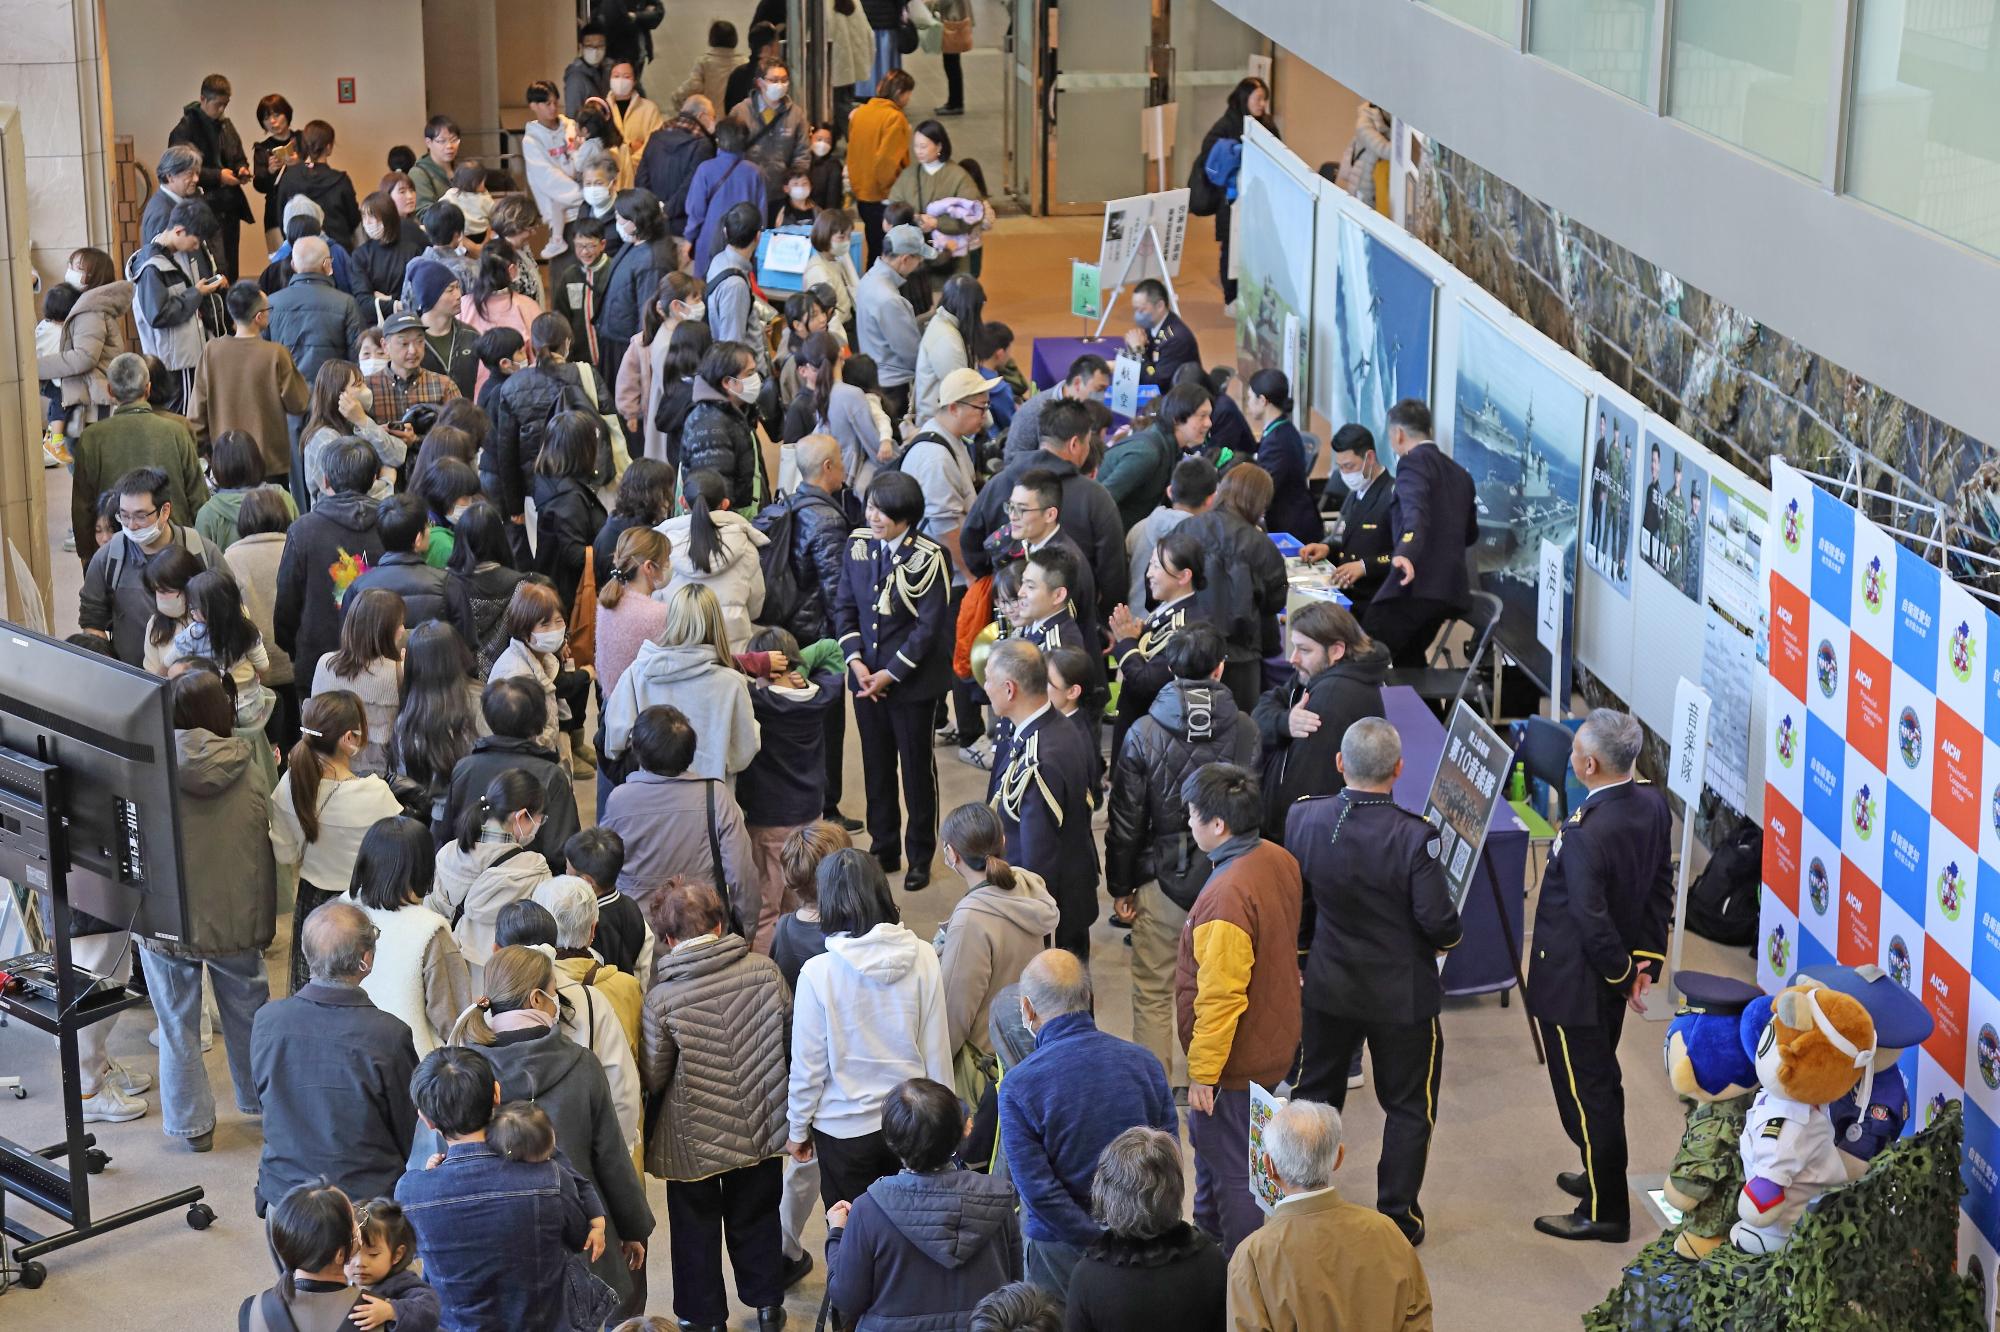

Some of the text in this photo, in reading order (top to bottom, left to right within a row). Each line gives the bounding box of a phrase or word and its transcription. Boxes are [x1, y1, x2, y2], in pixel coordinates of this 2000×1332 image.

[1777, 605, 1793, 625] AICHI
[1855, 668, 1873, 690] AICHI
[1863, 712, 1875, 729] Office
[1681, 701, 1699, 783] 音楽隊
[1941, 739, 1961, 763] AICHI
[1448, 736, 1496, 799] 第10音楽隊
[1947, 761, 1967, 782] Provincial
[1949, 773, 1974, 800] Cooperation
[1952, 786, 1965, 803] Office
[1771, 816, 1786, 838] AICHI
[1845, 890, 1863, 915] AICHI
[1930, 973, 1949, 998] AICHI
